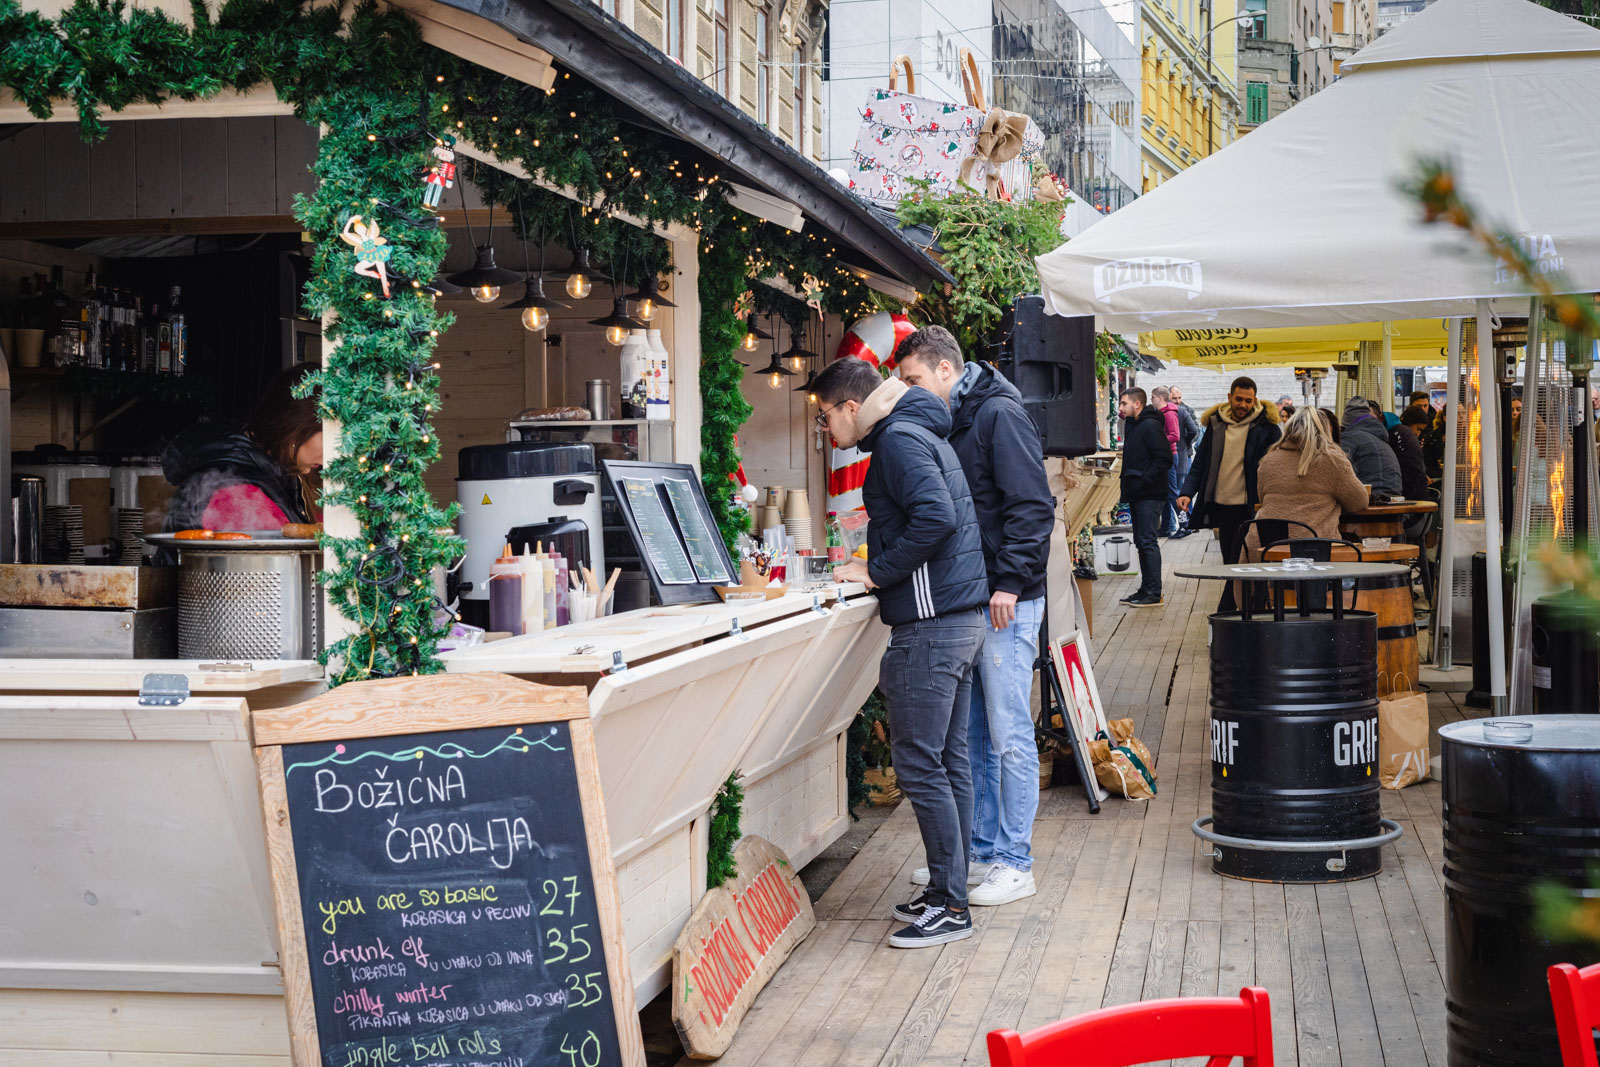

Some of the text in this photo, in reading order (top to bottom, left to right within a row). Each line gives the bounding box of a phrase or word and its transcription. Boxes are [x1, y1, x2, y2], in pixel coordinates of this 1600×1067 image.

[1210, 718, 1239, 765] RIF
[1334, 717, 1377, 766] GRIF
[386, 812, 532, 869] ČAROLIJA
[319, 880, 498, 935] you are so basic
[539, 875, 582, 917] 27
[401, 910, 466, 928] KOBASICA
[472, 908, 481, 920] U
[323, 936, 430, 968] drunk elf
[544, 923, 591, 965] 35
[351, 962, 406, 983] KOBASICA
[565, 972, 602, 1009] 35
[334, 982, 453, 1018] chilly winter
[417, 1006, 469, 1023] KOBASICA
[344, 1035, 401, 1067] jingle
[412, 1035, 450, 1061] bell
[458, 1030, 502, 1055] rolls
[560, 1030, 600, 1067] 40
